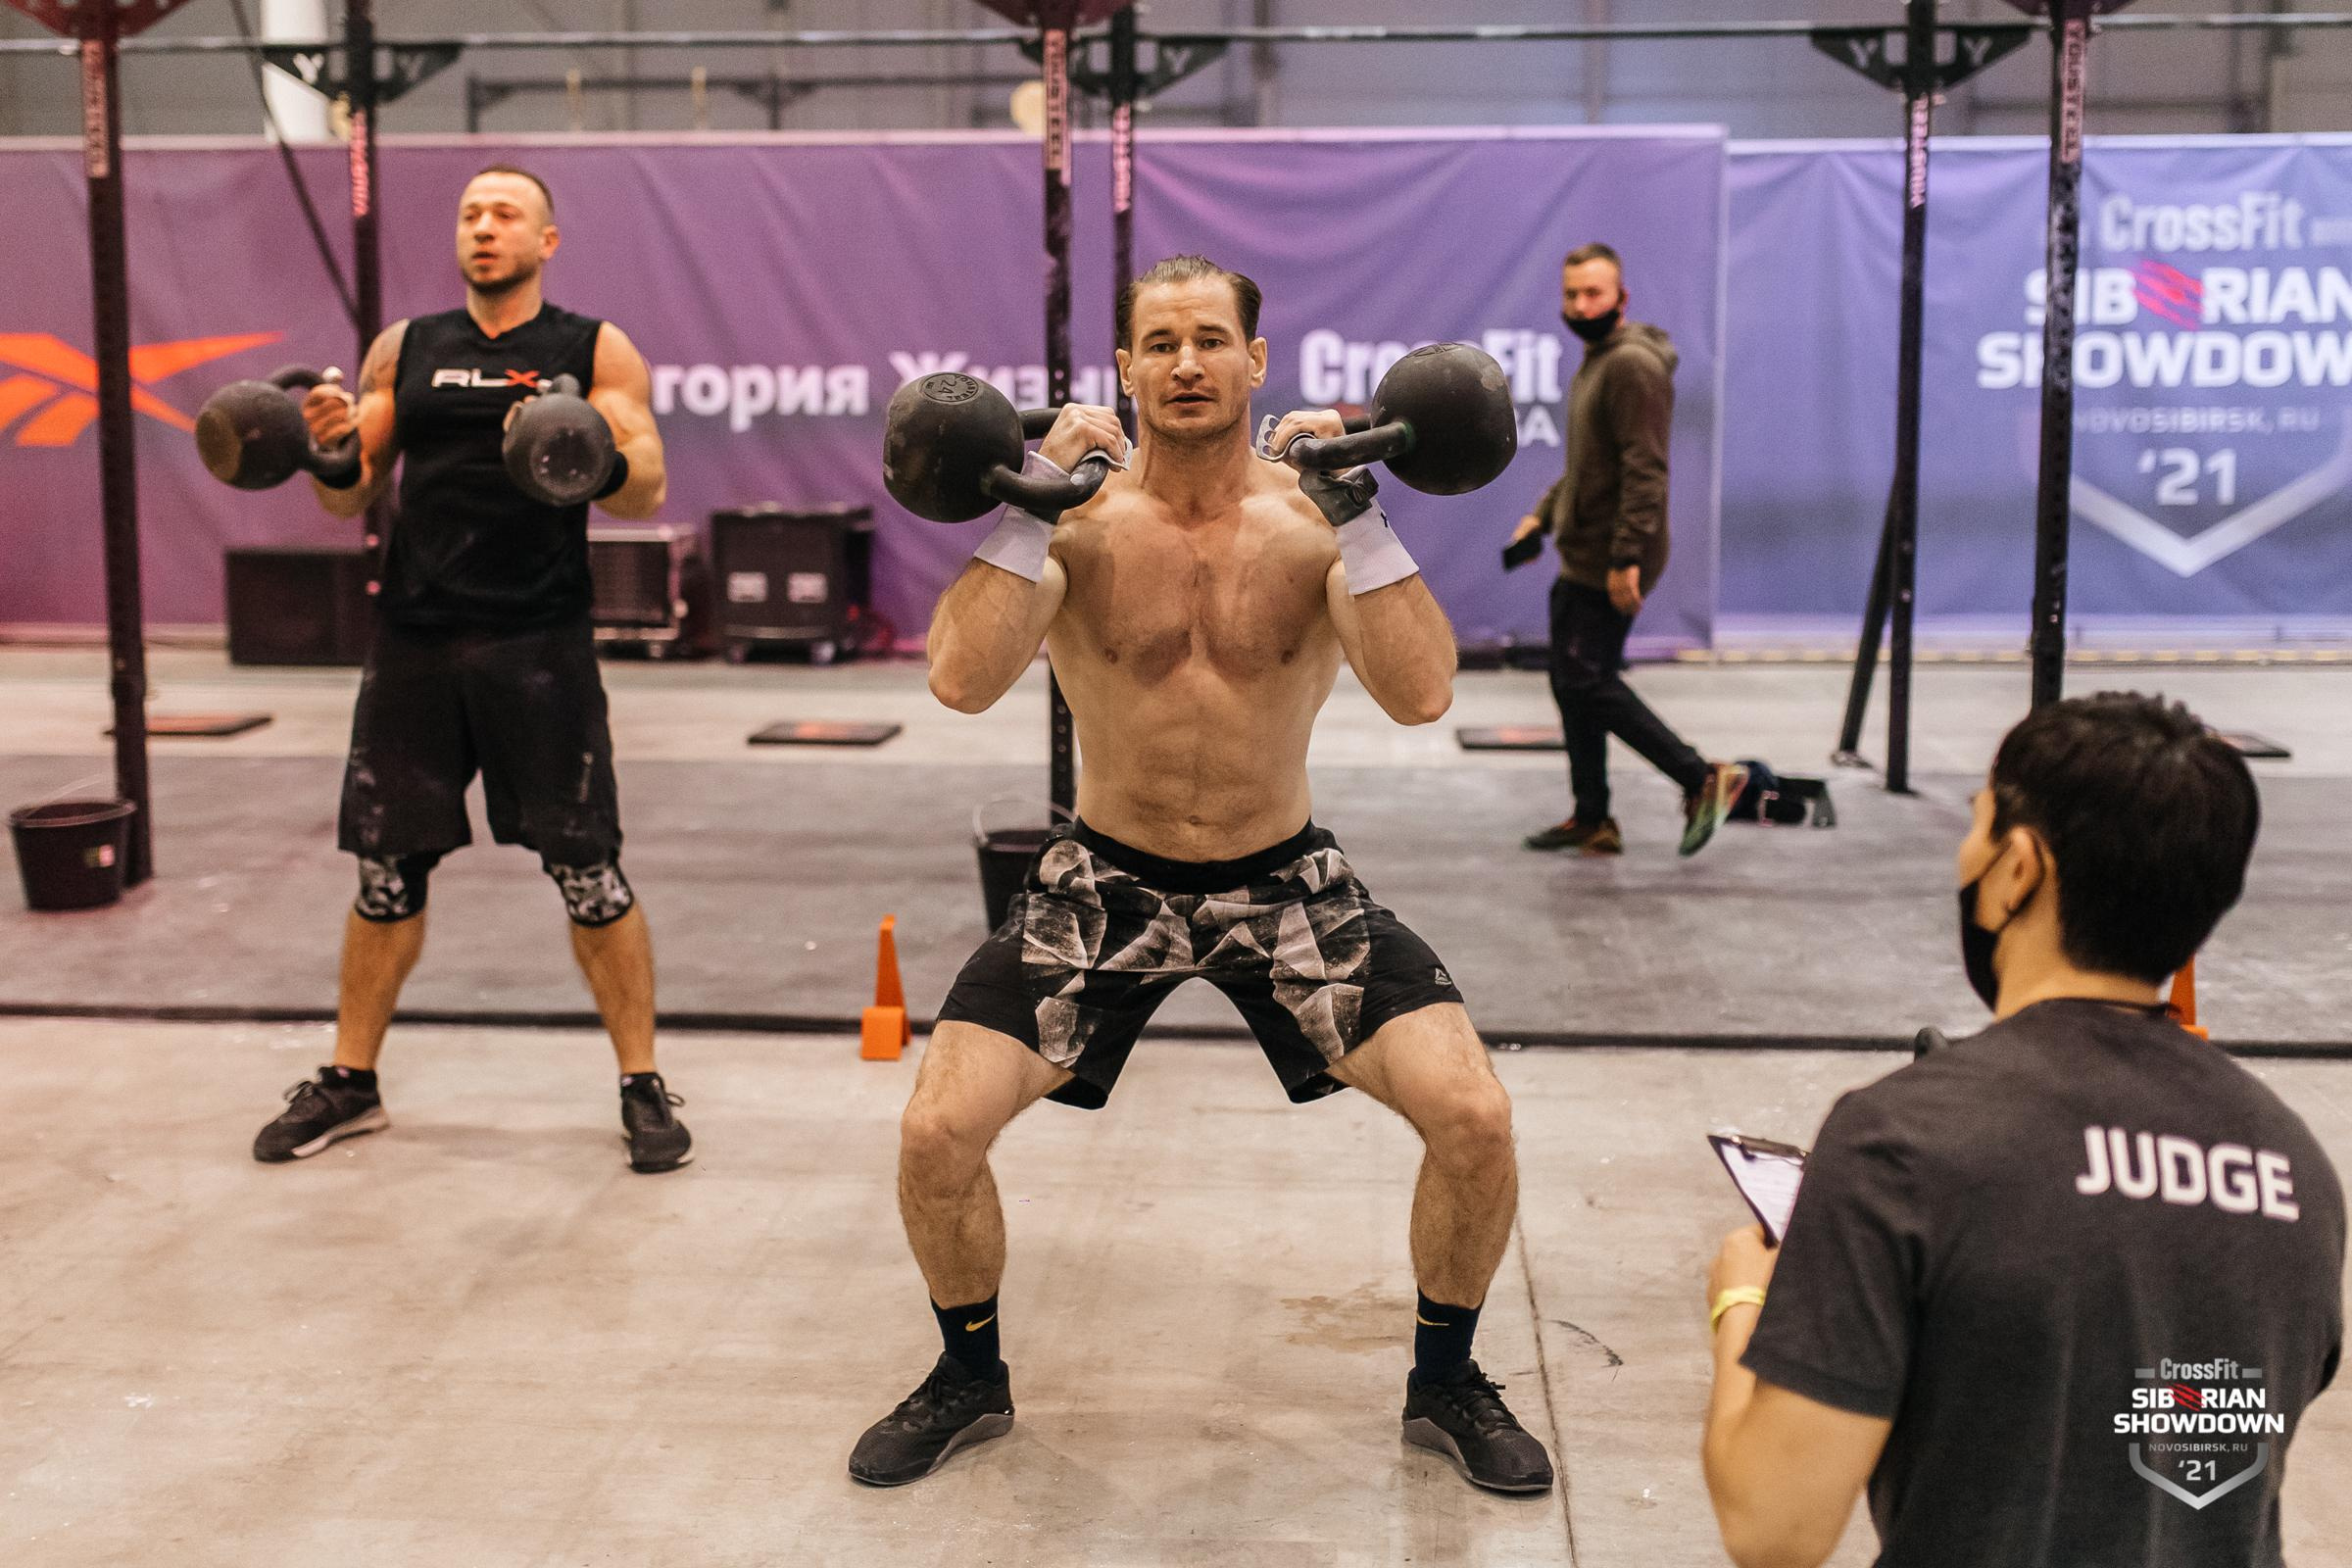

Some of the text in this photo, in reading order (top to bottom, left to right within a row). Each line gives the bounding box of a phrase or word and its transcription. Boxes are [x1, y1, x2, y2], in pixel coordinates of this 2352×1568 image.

[2100, 191, 2303, 253] CrossFit
[2023, 266, 2352, 326] SIBRIAN
[1299, 328, 1563, 405] CrFit
[2075, 1125, 2300, 1223] JUDGE
